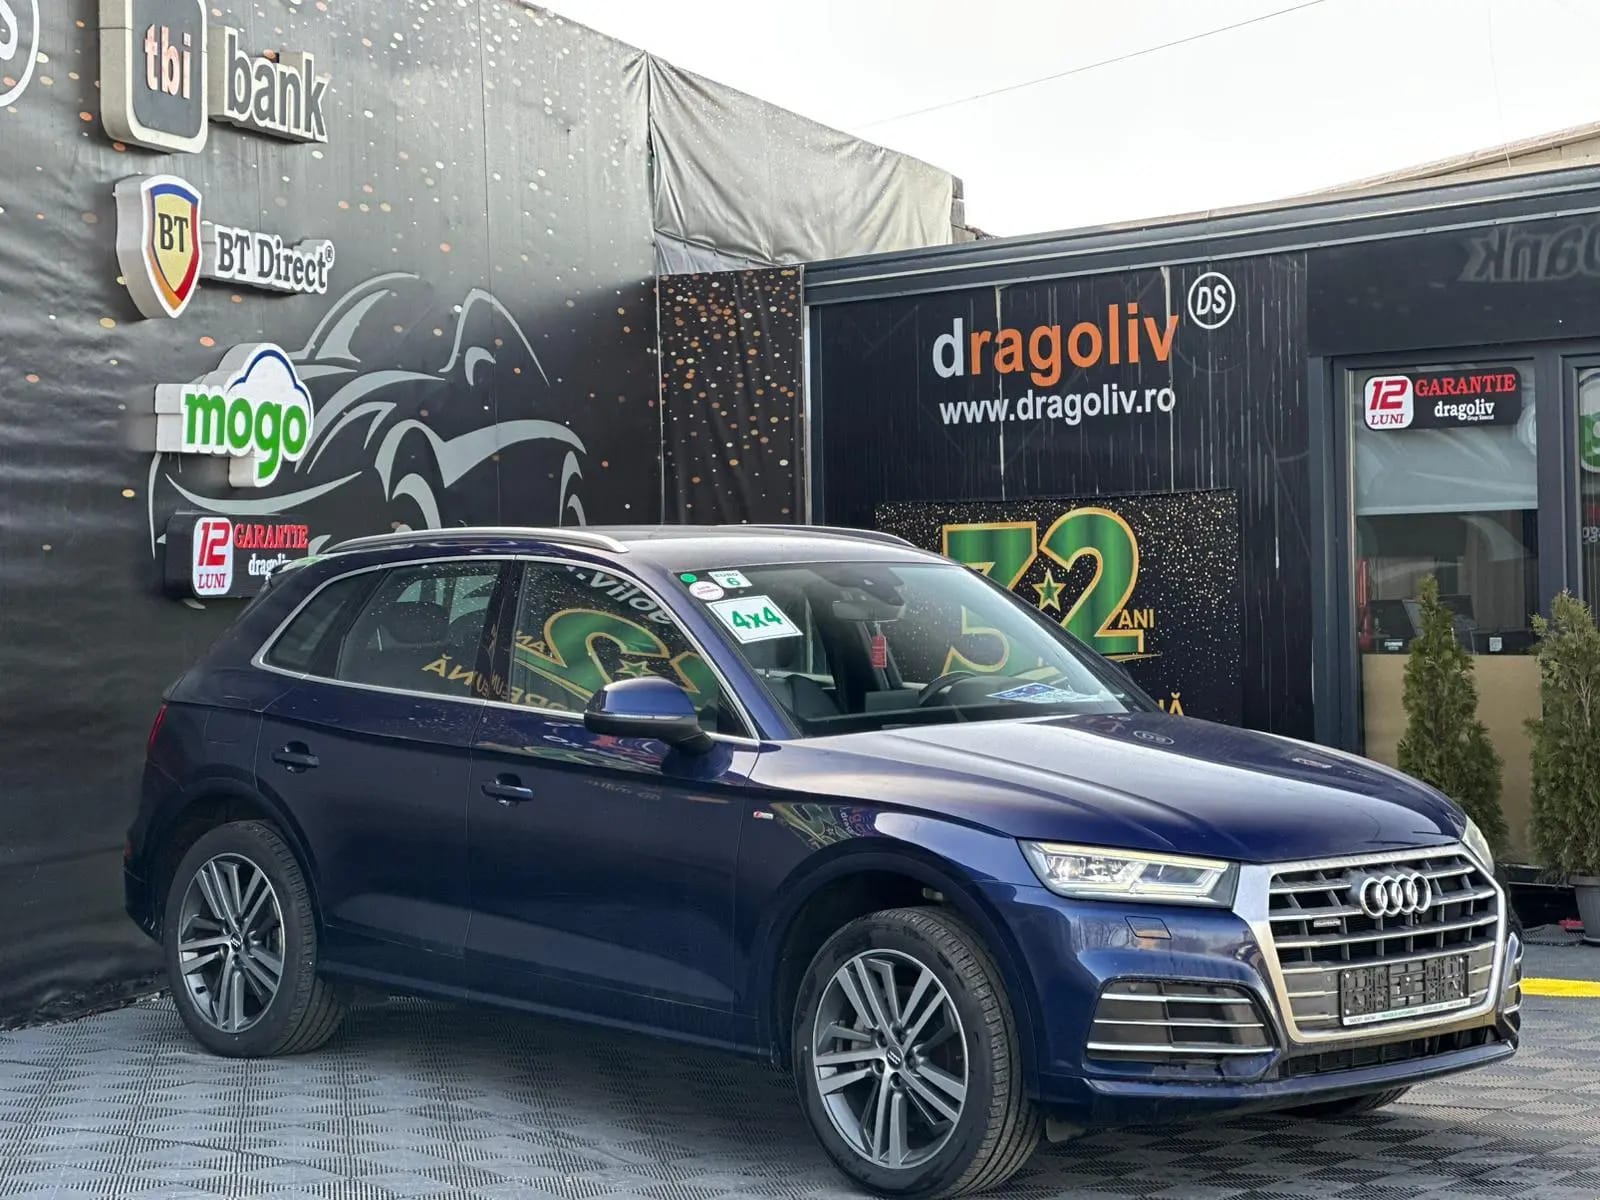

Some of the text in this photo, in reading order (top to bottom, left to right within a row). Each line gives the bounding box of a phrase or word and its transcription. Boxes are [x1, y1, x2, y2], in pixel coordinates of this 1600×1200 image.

[144, 23, 327, 141] tbi bank
[157, 212, 189, 253] BT
[217, 231, 251, 277] BT
[1196, 283, 1228, 316] DS
[932, 301, 1179, 387] dragoliv
[939, 383, 1177, 427] www.dragoliv.ro
[1369, 373, 1517, 411] 12 GARANTIE
[1434, 398, 1496, 421] dragoliv
[184, 392, 308, 480] mogo
[1370, 412, 1405, 427] LUNI
[197, 520, 309, 567] 12 GARANTIE
[197, 572, 227, 590] LUNI
[726, 577, 742, 587] 6
[731, 606, 784, 630] 4x4
[1118, 607, 1156, 630] ANI
